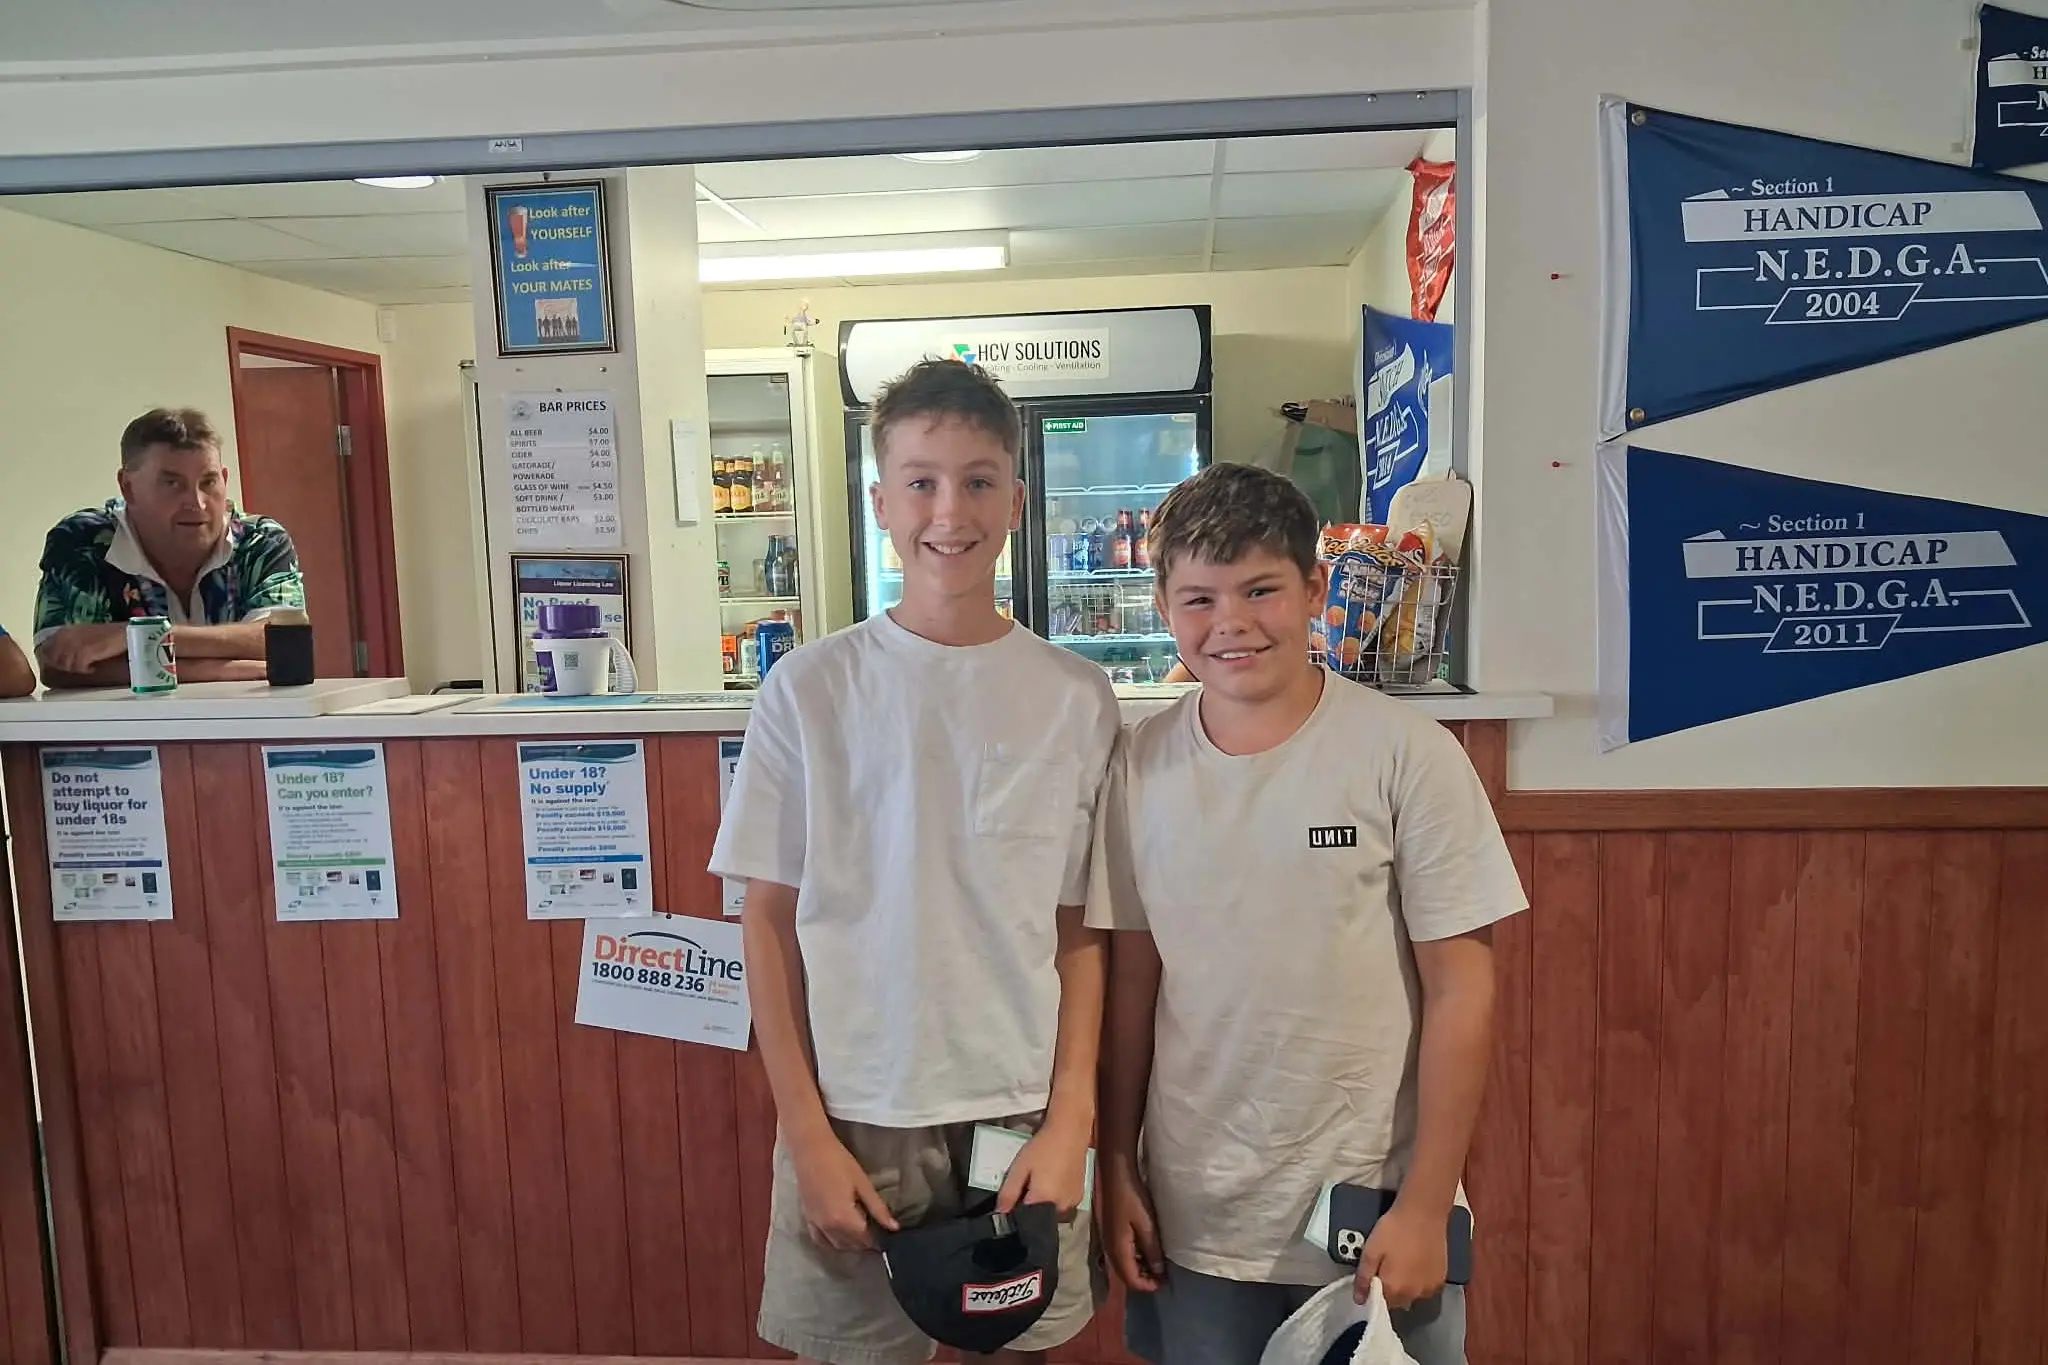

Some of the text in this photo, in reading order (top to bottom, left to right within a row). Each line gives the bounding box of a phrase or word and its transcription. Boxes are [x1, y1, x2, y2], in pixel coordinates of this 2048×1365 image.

[2031, 45, 2048, 59] Se
[1751, 179, 1819, 196] Section
[1825, 177, 1834, 192] 1
[529, 205, 591, 219] Look after
[1744, 202, 1931, 233] HANDICAP
[530, 226, 593, 240] YOURSELF
[511, 258, 571, 272] Look after
[1755, 243, 1987, 282] N.E.D.G.A.
[511, 279, 593, 294] YOUR MATES
[1806, 291, 1880, 317] 2004
[978, 339, 1101, 361] HCV SOLUTIONS
[1017, 362, 1048, 373] Cooling
[1055, 360, 1101, 370] Ventilation
[539, 400, 607, 412] BAR PRICES
[524, 429, 543, 437] BEER
[588, 427, 609, 435] $4.00
[1053, 422, 1084, 430] FIRST AID
[511, 438, 609, 448] SPIRITS $7.00
[511, 450, 610, 459] CIDER $4.00
[514, 484, 537, 492] GLASS
[550, 483, 569, 491] WINE
[515, 494, 533, 502] SOFT
[535, 494, 558, 502] DRINK
[516, 505, 575, 513] BOTTLED WATER
[1768, 514, 1848, 533] Section
[1856, 512, 1865, 529] 1
[1735, 539, 1948, 571] HANDICAP
[523, 597, 544, 608] No
[1753, 578, 1959, 614] N.E.D.G.A.
[1794, 623, 1869, 645] 2011
[772, 643, 794, 653] DR
[52, 772, 99, 784] Do not
[276, 772, 345, 785] Under 18?
[529, 767, 607, 780] Under 18?
[52, 785, 129, 799] attempt to
[278, 786, 373, 802] Can you enter?
[530, 783, 551, 795] No
[54, 799, 148, 814] buy liquor for
[55, 813, 127, 826] under 18s
[1312, 828, 1353, 846] UNIT
[594, 934, 744, 981] DirectLine
[592, 961, 635, 981] 1800
[637, 968, 672, 987] 888
[674, 974, 705, 992] 236
[968, 1276, 1037, 1304] Titleist
